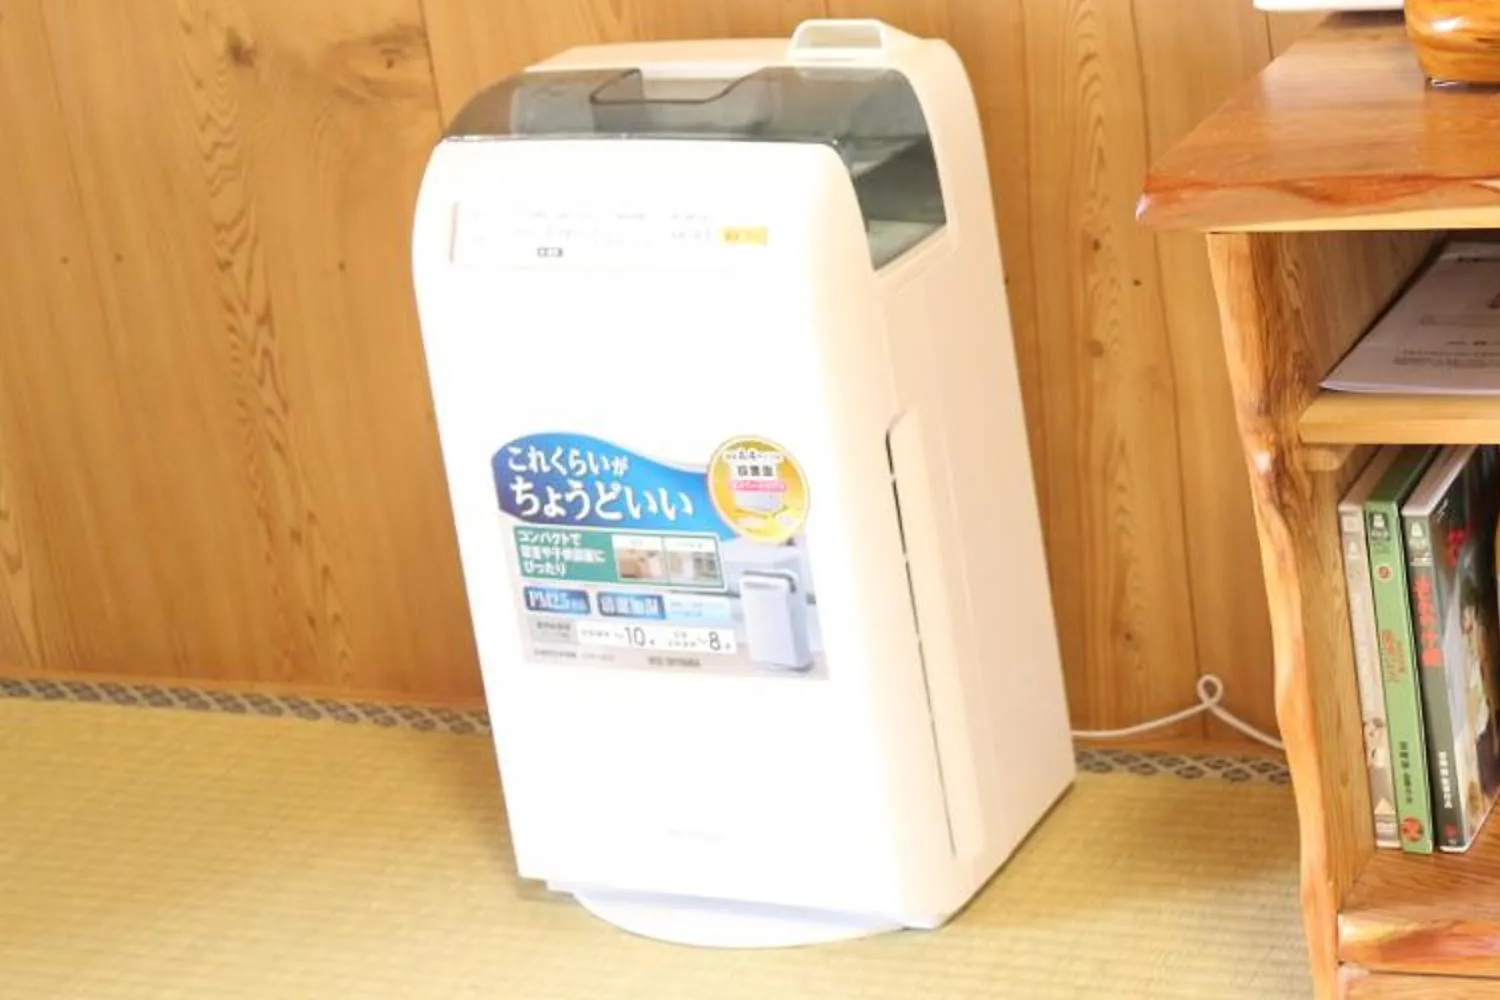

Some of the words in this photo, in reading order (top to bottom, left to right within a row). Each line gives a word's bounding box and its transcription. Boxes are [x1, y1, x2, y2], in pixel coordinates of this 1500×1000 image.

[508, 444, 629, 478] これくらいが
[510, 477, 695, 522] ちょうどいい
